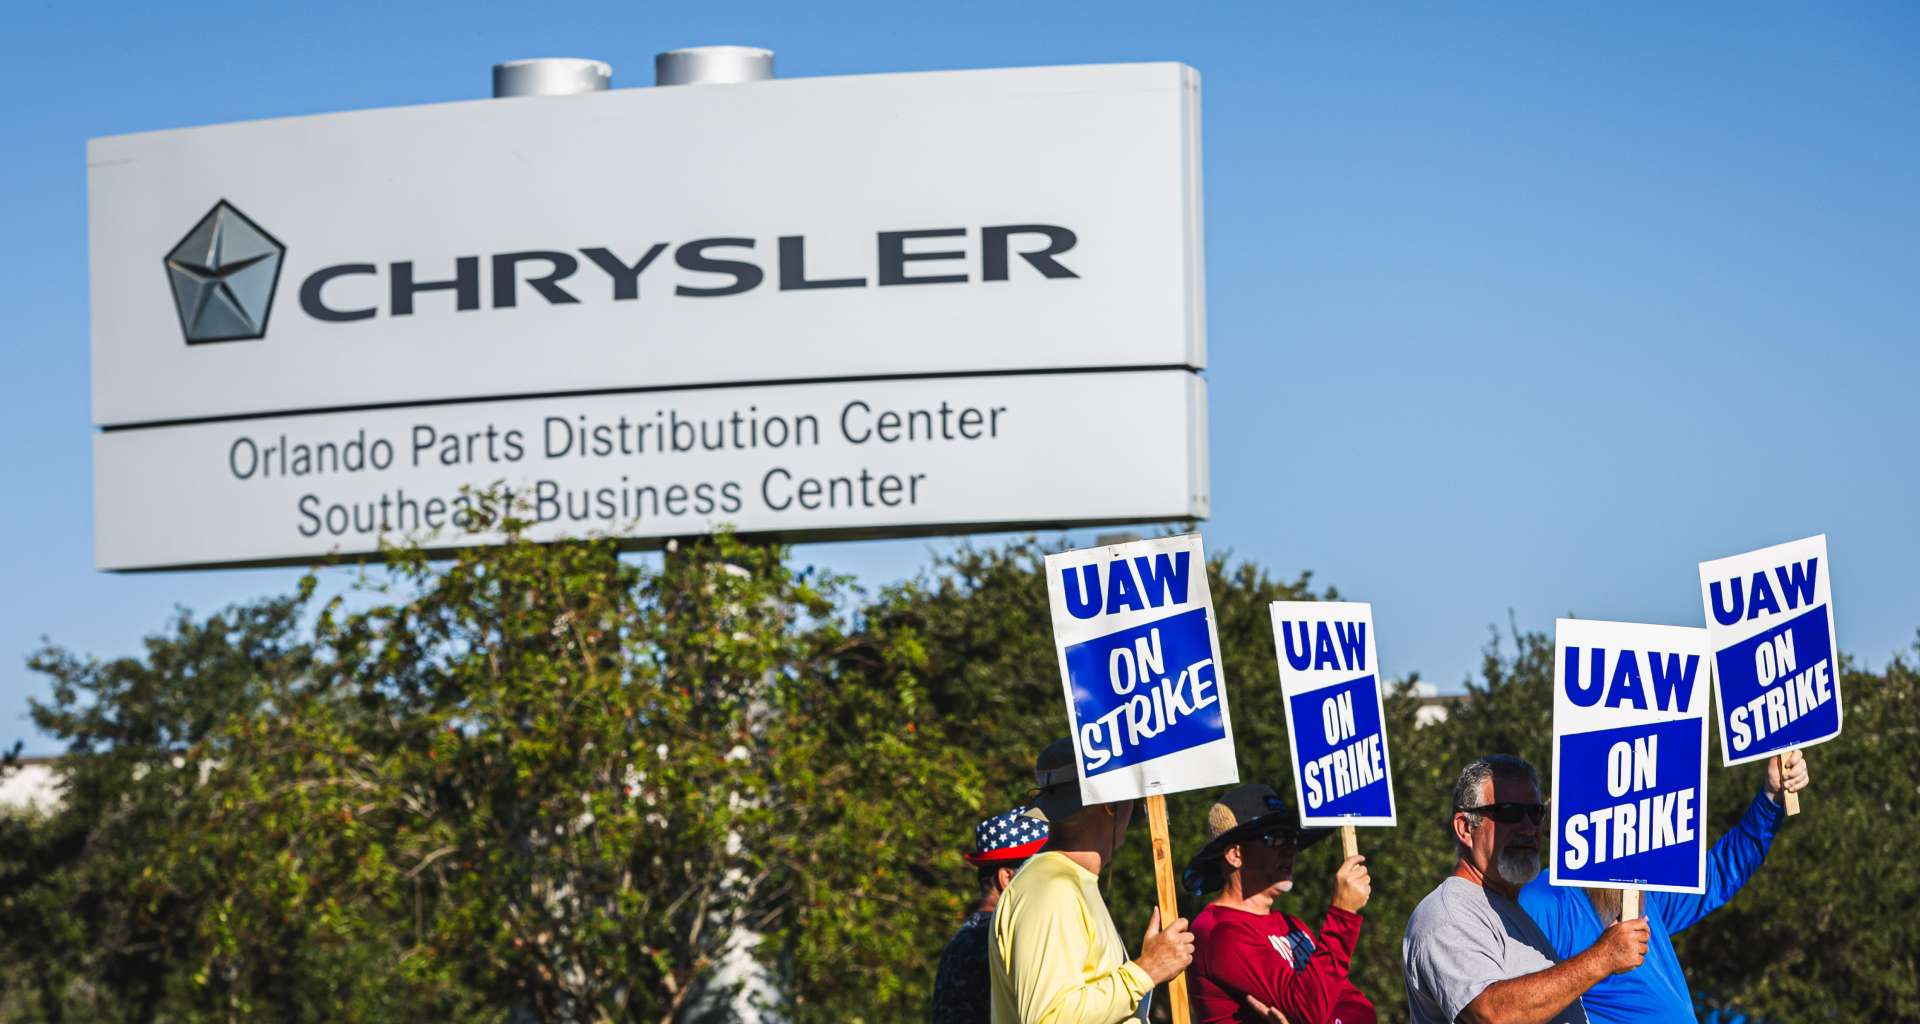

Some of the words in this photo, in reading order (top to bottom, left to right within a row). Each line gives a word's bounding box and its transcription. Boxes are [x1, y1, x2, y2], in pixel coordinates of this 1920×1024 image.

[299, 224, 1081, 324] CHRYSLER
[229, 430, 393, 480] Orlando
[412, 424, 524, 467] Parts
[544, 406, 819, 459] Distribution
[840, 400, 1007, 445] Center
[298, 486, 517, 538] Southeast
[535, 475, 743, 523] Business
[761, 468, 926, 512] Center
[1061, 551, 1190, 620] UAW
[1708, 557, 1818, 626] UAW
[1109, 628, 1165, 695] ON
[1281, 620, 1366, 672] UAW
[1564, 646, 1700, 713] UAW
[1754, 628, 1797, 688] ON
[1080, 659, 1218, 771] STRIKE
[1322, 690, 1356, 746] ON
[1730, 659, 1832, 751] STRIKE
[1304, 733, 1384, 810] STRIKE
[1607, 734, 1658, 798] ON
[1564, 787, 1695, 870] STRIKE
